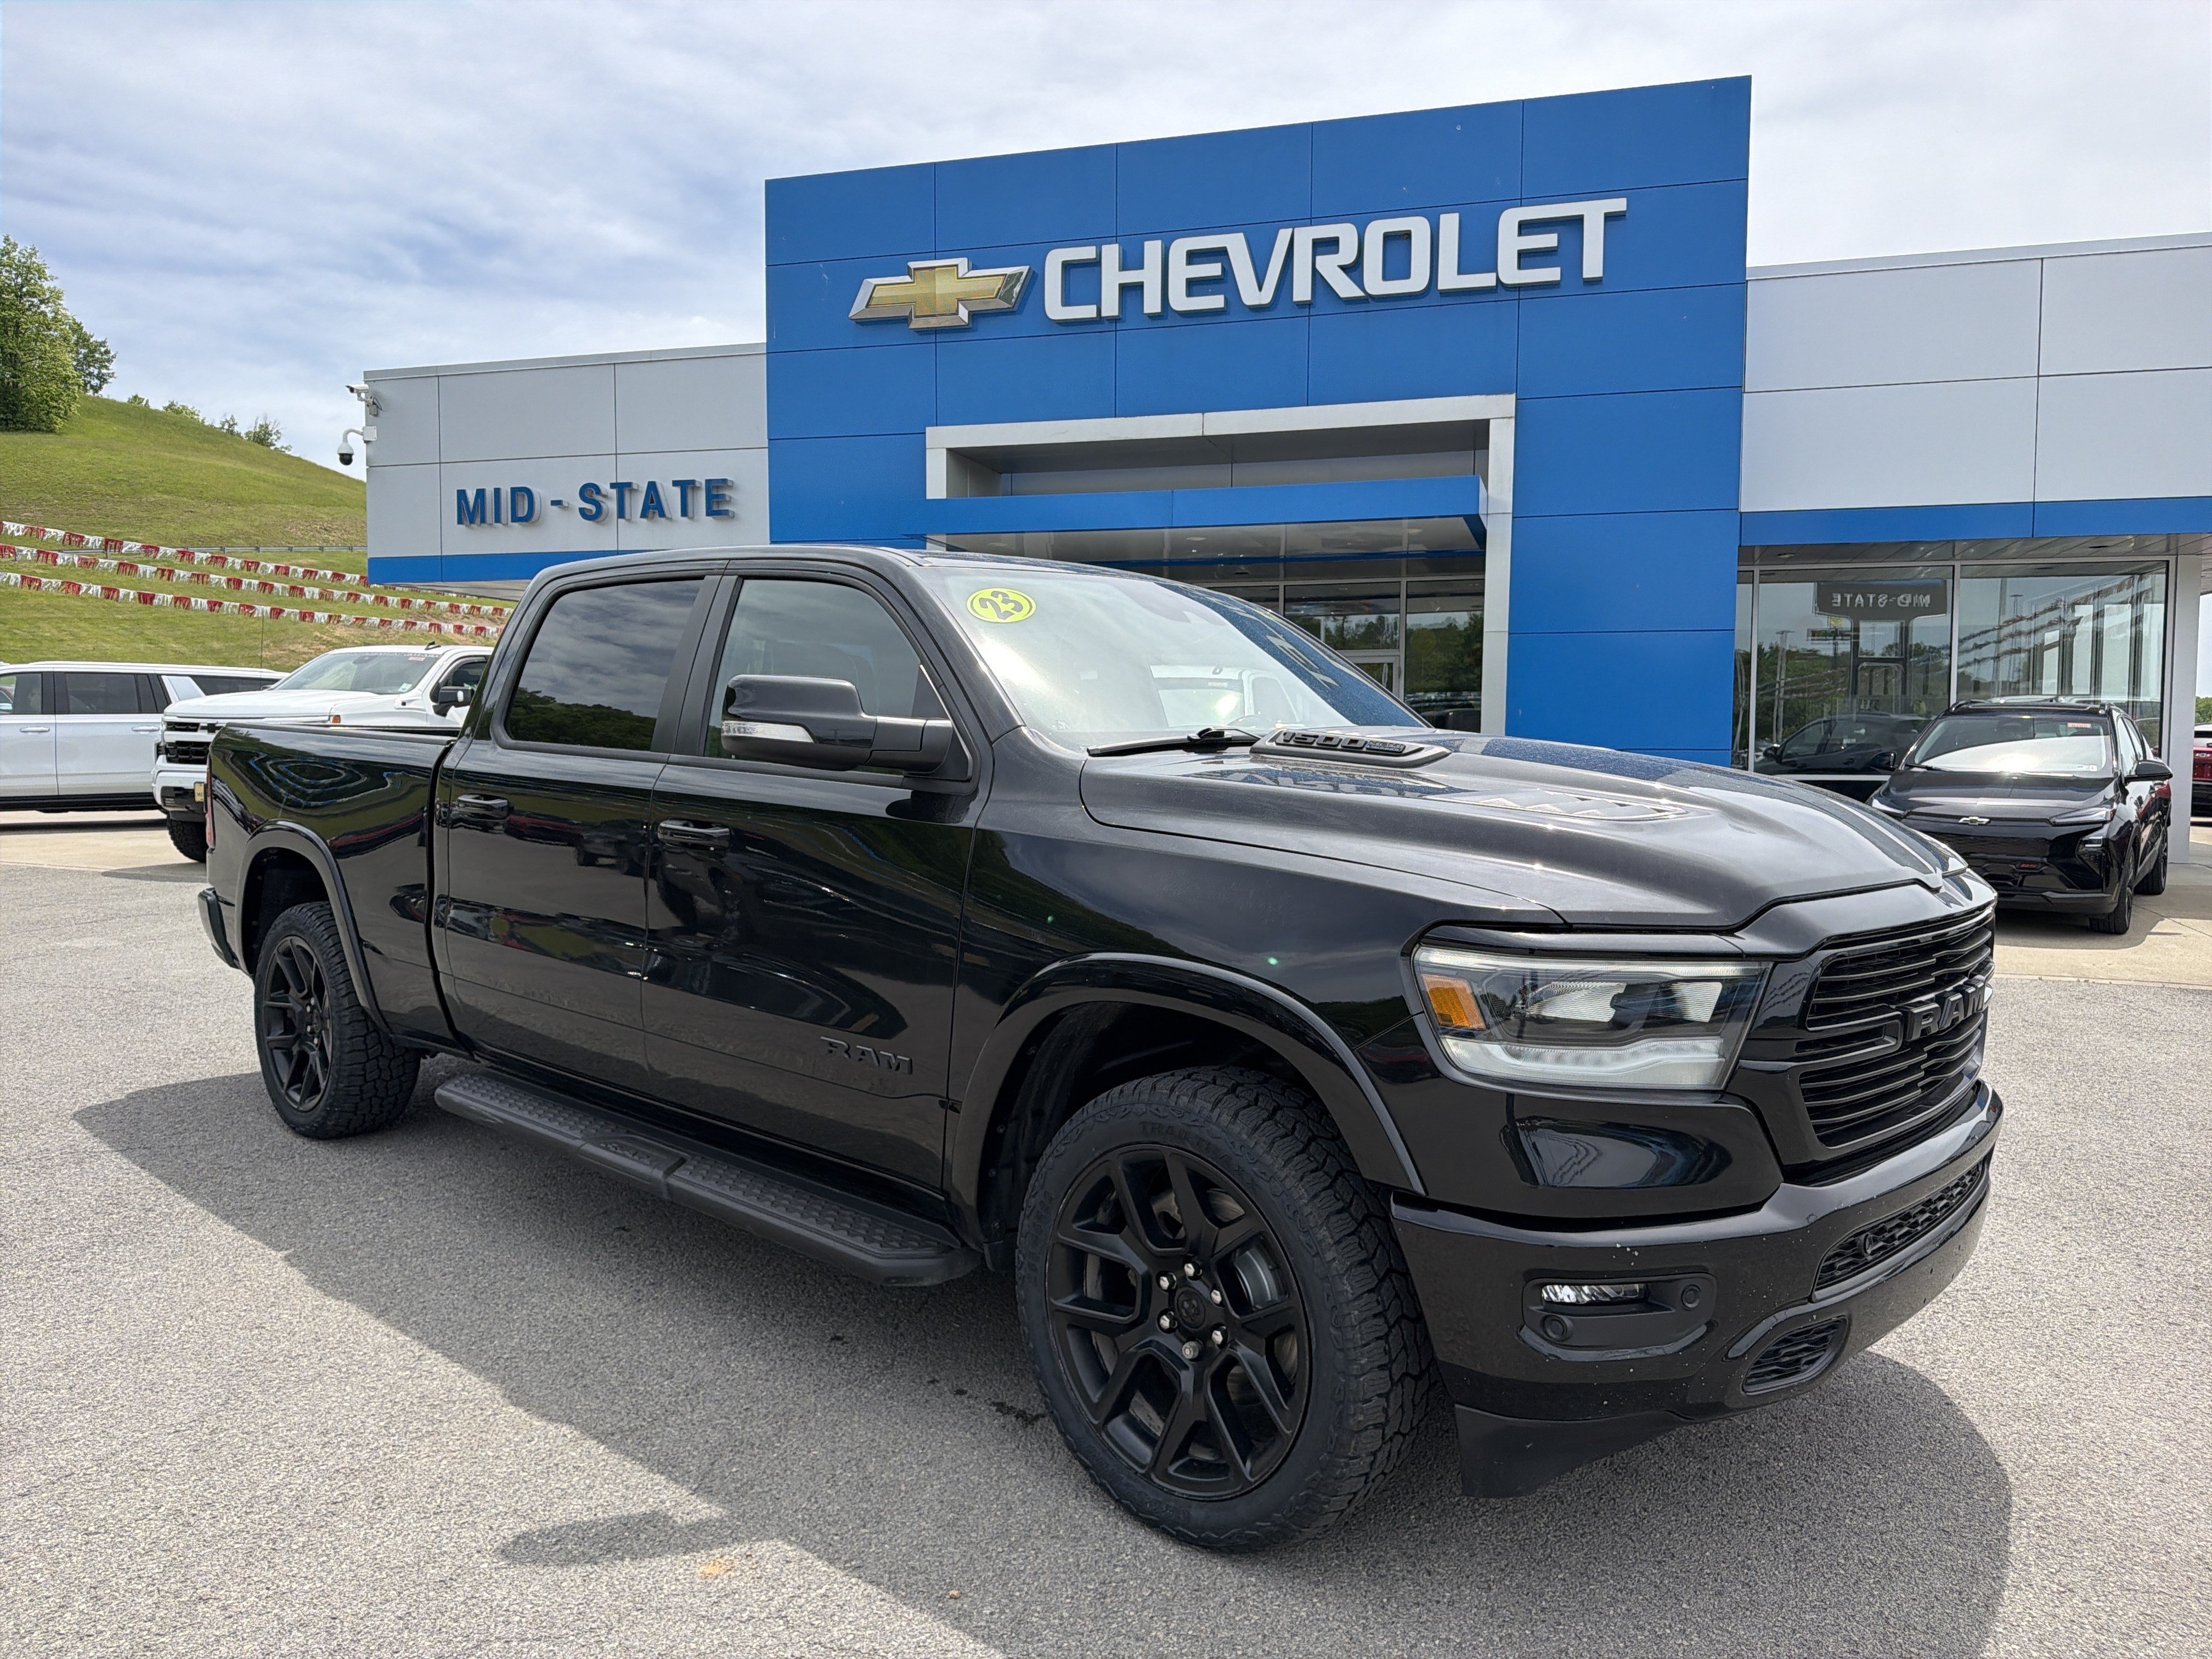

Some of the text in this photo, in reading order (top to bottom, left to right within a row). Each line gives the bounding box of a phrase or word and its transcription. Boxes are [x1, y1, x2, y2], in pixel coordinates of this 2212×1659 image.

[1043, 197, 1627, 321] CHEVROLET
[979, 590, 1024, 620] 23
[1282, 732, 1368, 749] 1500
[1907, 981, 1985, 1042] RAM
[821, 1036, 913, 1075] RAM
